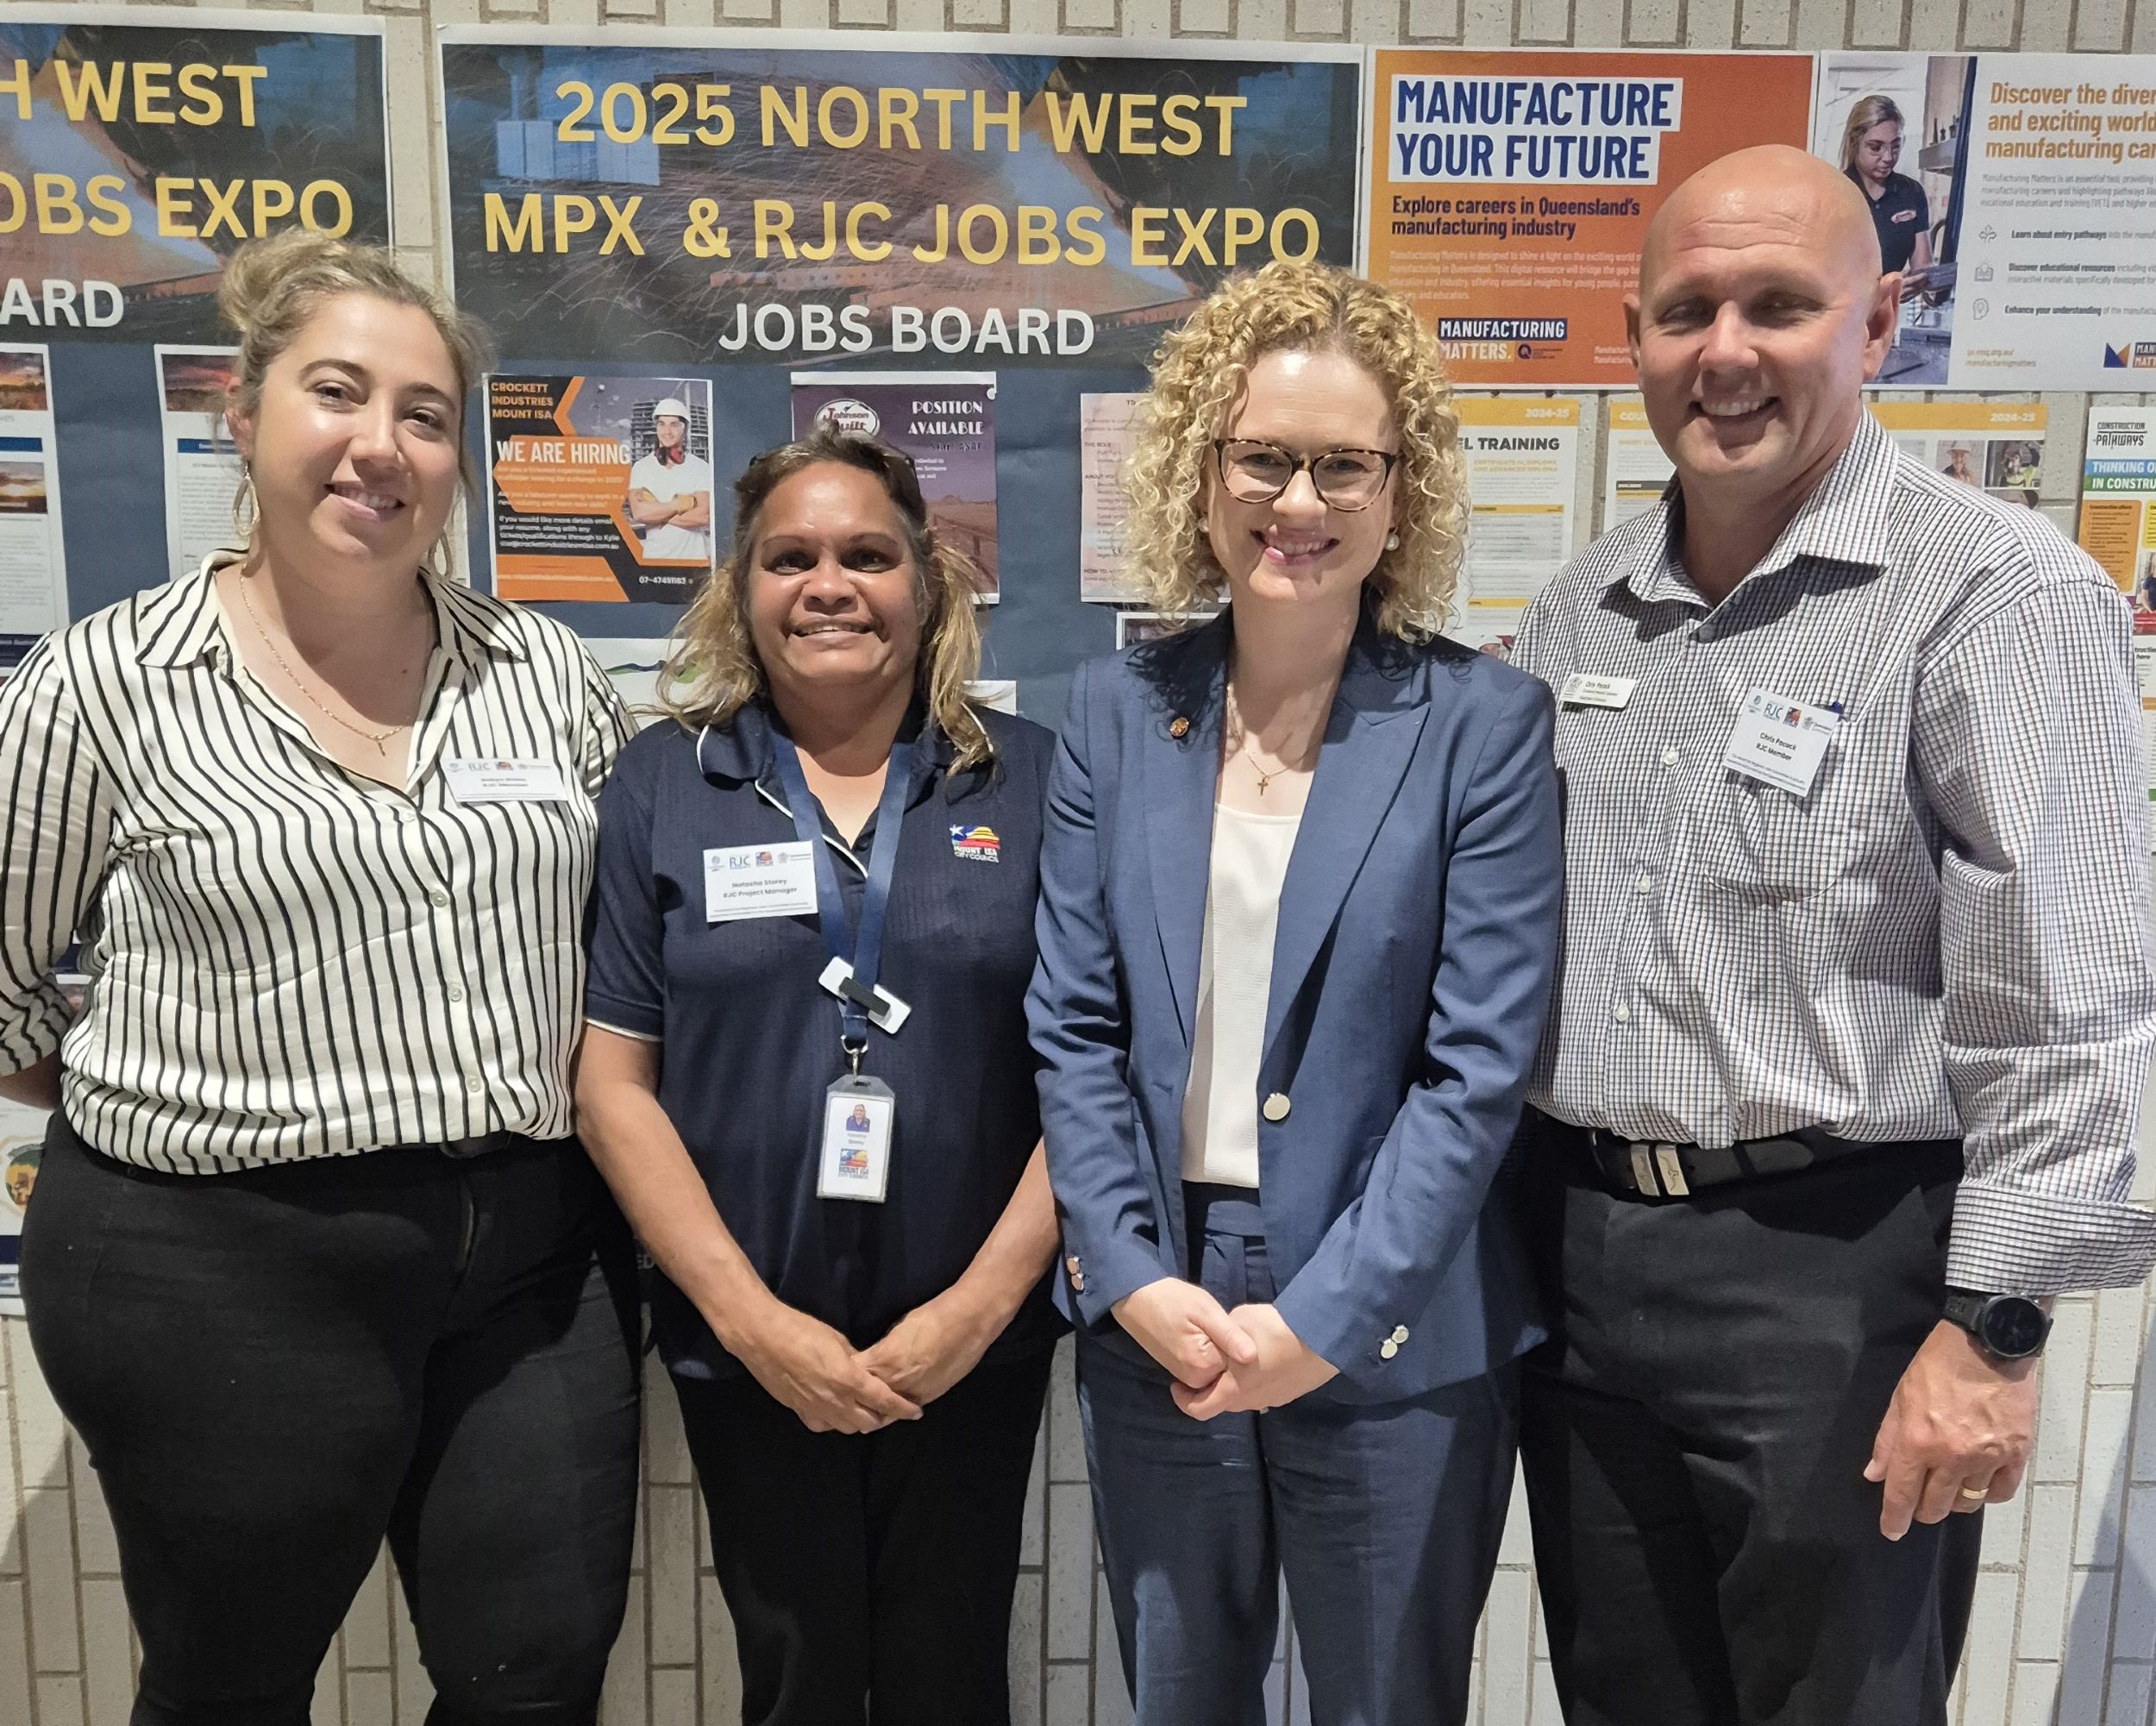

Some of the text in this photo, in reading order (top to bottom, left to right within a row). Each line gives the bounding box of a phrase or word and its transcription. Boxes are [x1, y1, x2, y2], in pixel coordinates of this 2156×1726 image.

[54, 60, 267, 128] WEST
[1990, 82, 2072, 104] Discover
[2077, 83, 2107, 104] the
[1397, 79, 1674, 127] MANUFACTURE
[555, 81, 1247, 157] 2025 NORTH WEST
[1988, 110, 2156, 137] and exciting world
[1396, 133, 1651, 179] YOUR FUTURE
[1985, 137, 2123, 164] manufacturing
[156, 178, 353, 240] EXPO
[1393, 196, 1640, 217] Explore careers in Queensland's
[484, 193, 1319, 267] MPX & RJC JOBS EXPO
[1392, 217, 1576, 241] manufacturing industry
[2011, 229, 2107, 241] Learn about entry pathways
[2009, 262, 2038, 272] Discover
[2040, 262, 2080, 272] educational
[2081, 263, 2115, 272] resources
[0, 278, 124, 328] ARD
[2004, 305, 2102, 317] Enhance your understanding
[718, 303, 1094, 356] JOBS BOARD
[1440, 320, 1565, 338] MANUFACTURING
[491, 382, 548, 392] CROCKETT
[492, 396, 554, 406] INDUSTRIES
[912, 401, 983, 414] POSITION
[492, 409, 553, 419] MOUNT ISA
[1526, 408, 1570, 418] 2024-25
[908, 421, 983, 435] AVAILABLE
[1478, 437, 1560, 450] TRAINING
[2096, 432, 2144, 448] PATHWAYS
[497, 441, 632, 465] WE ARE HIRING
[2093, 461, 2144, 474] THINKING
[2092, 478, 2156, 489] IN CONSTRU
[1764, 702, 1783, 719] RJC
[1759, 732, 1776, 744] Chris
[1756, 743, 1793, 761] RJC Member
[729, 855, 751, 867] RJC
[731, 879, 762, 888] Natasha
[738, 888, 763, 898] Project
[764, 887, 797, 895] Manager
